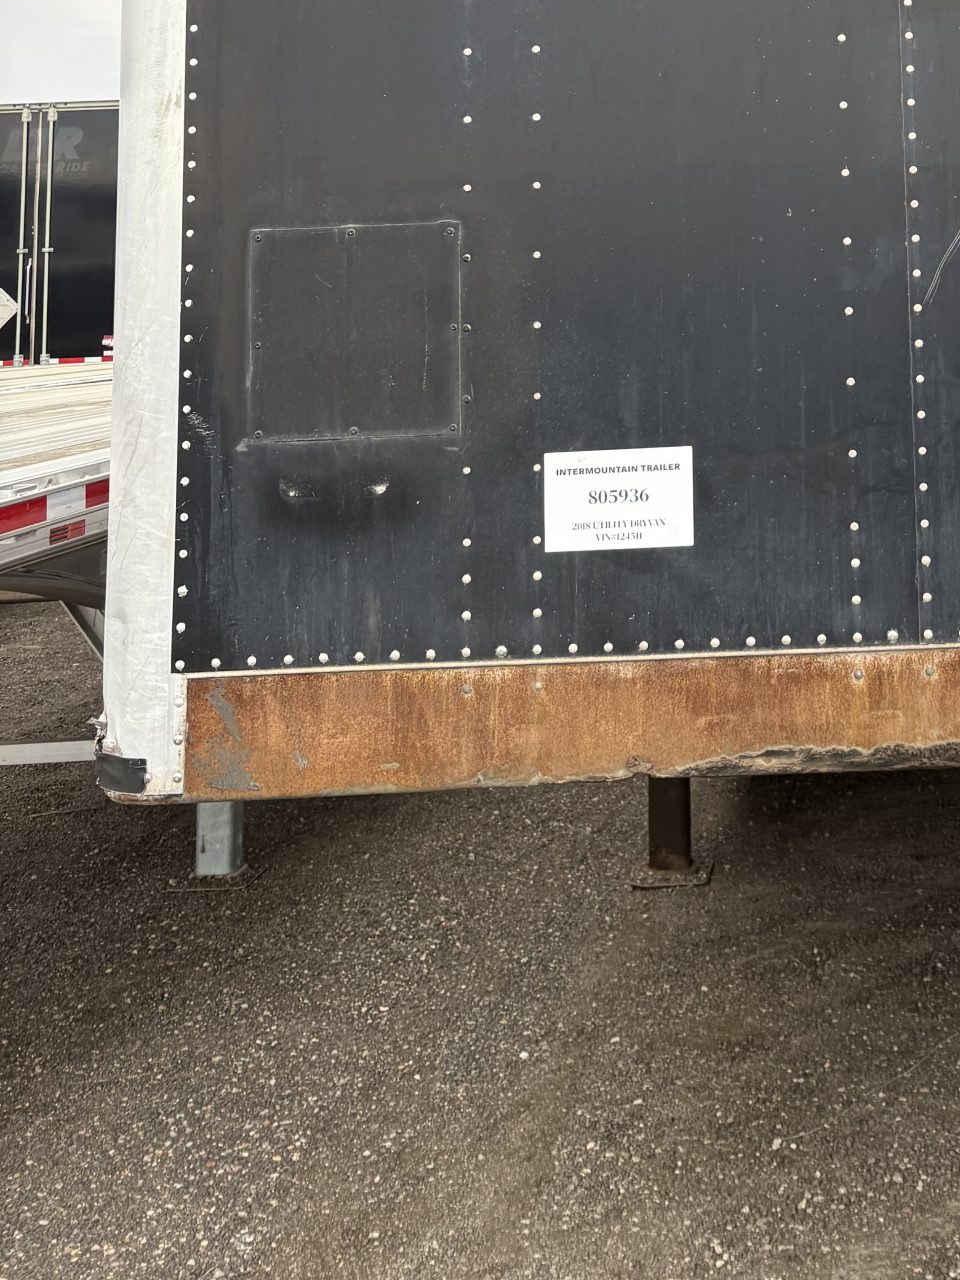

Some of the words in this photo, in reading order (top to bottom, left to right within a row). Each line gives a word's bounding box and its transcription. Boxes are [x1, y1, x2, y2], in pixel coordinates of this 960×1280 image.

[556, 465, 638, 476] INTERMOUNTAIN
[641, 463, 681, 472] TRAILER
[588, 488, 650, 505] 805936
[592, 520, 628, 529] UTILITY
